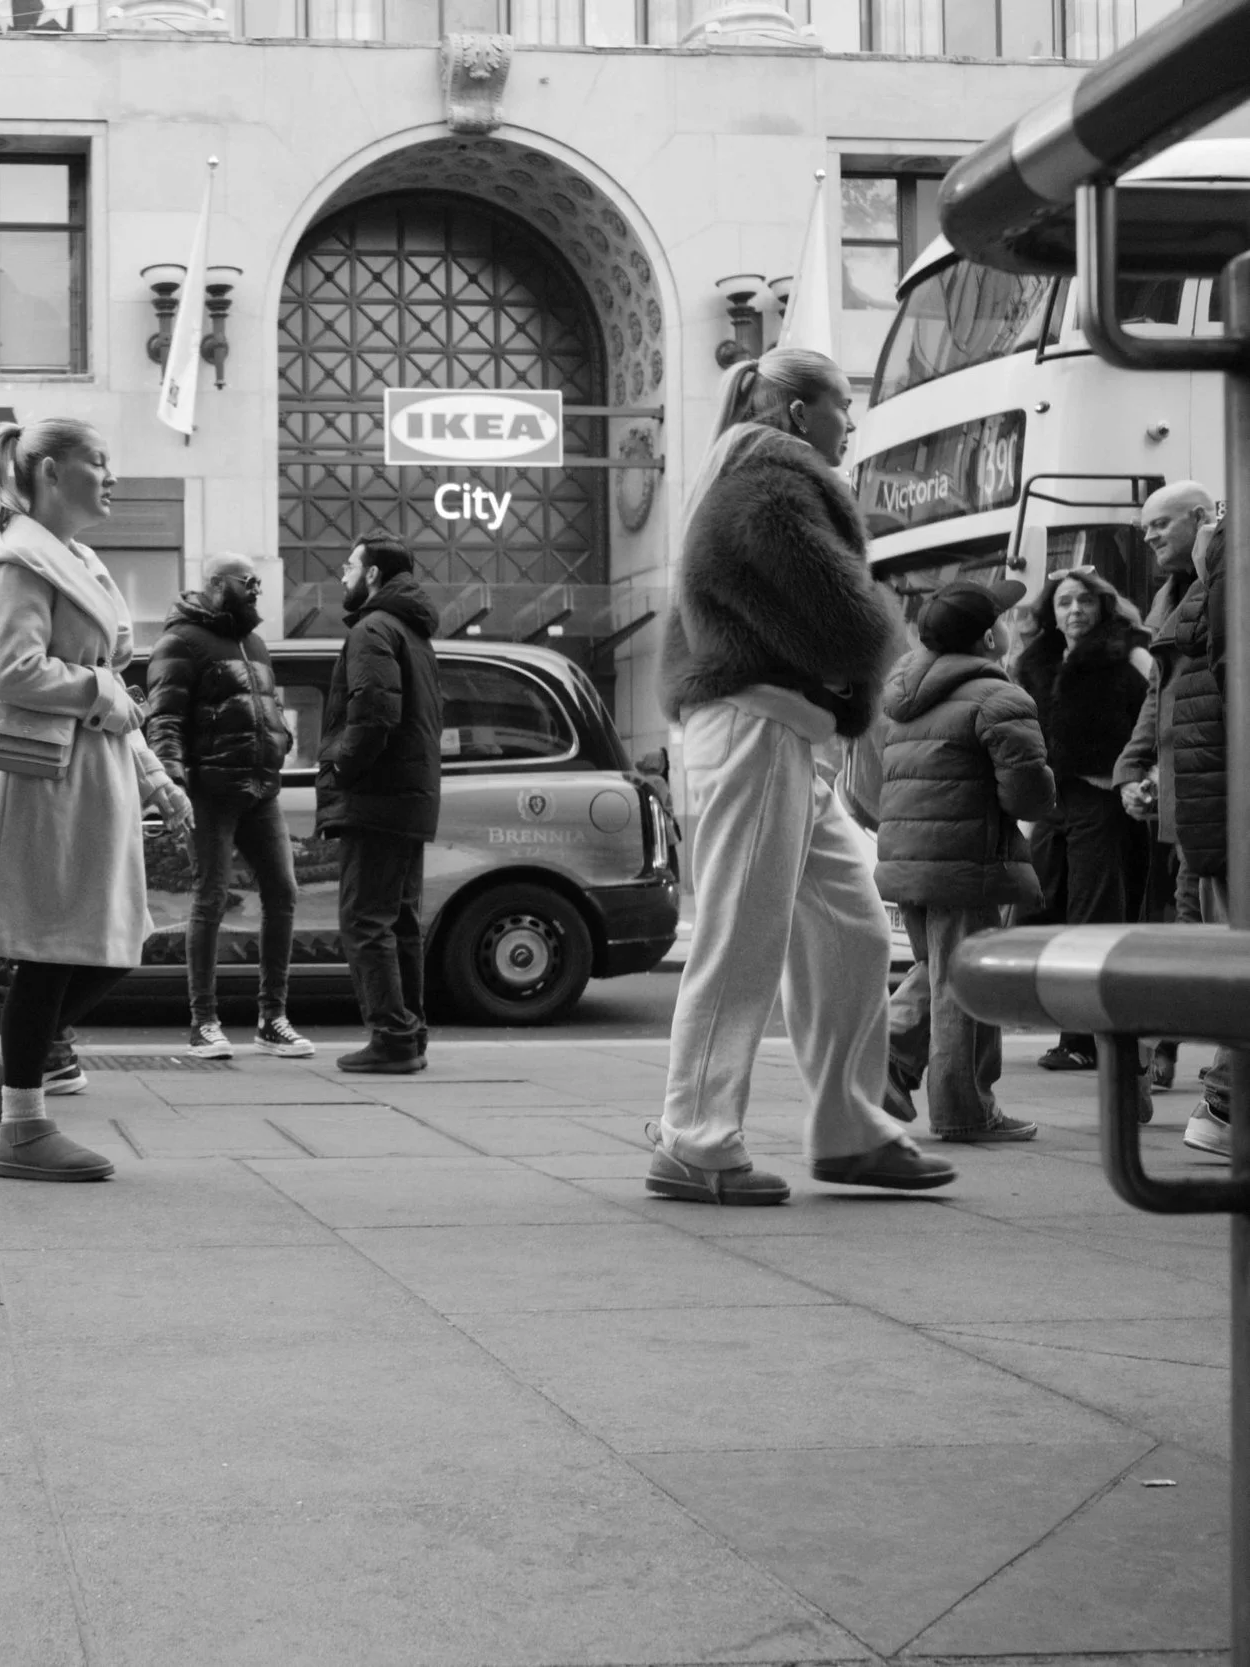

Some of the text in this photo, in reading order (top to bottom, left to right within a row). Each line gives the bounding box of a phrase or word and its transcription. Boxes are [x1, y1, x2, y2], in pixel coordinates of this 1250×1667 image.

[406, 412, 546, 440] IKEA
[434, 482, 512, 530] City
[883, 470, 949, 512] Victoria
[488, 827, 586, 844] BRENNIA
